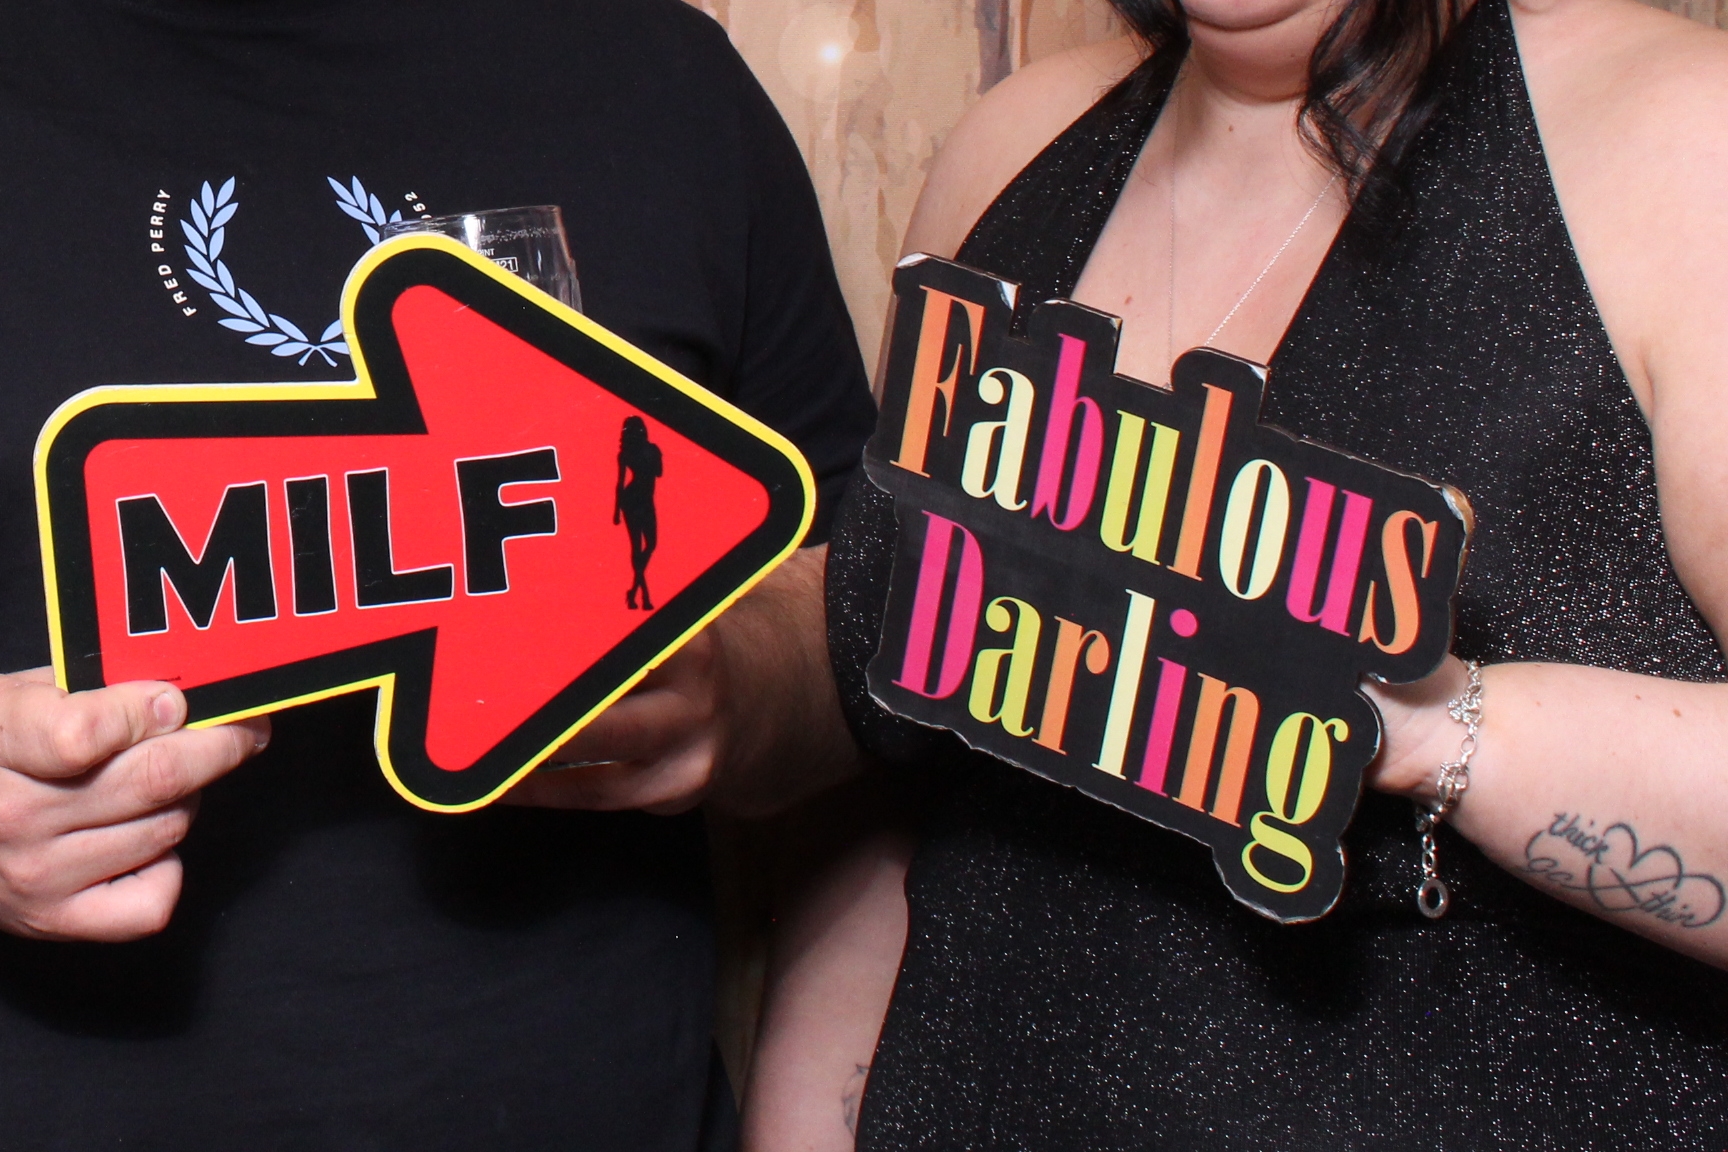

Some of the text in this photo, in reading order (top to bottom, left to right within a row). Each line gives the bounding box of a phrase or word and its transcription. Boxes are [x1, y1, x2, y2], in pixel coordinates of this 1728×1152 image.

[149, 189, 198, 317] FRED PERRY
[114, 446, 562, 636] MILF
[889, 285, 1439, 655] Fabulous
[891, 509, 1349, 894] Darling
